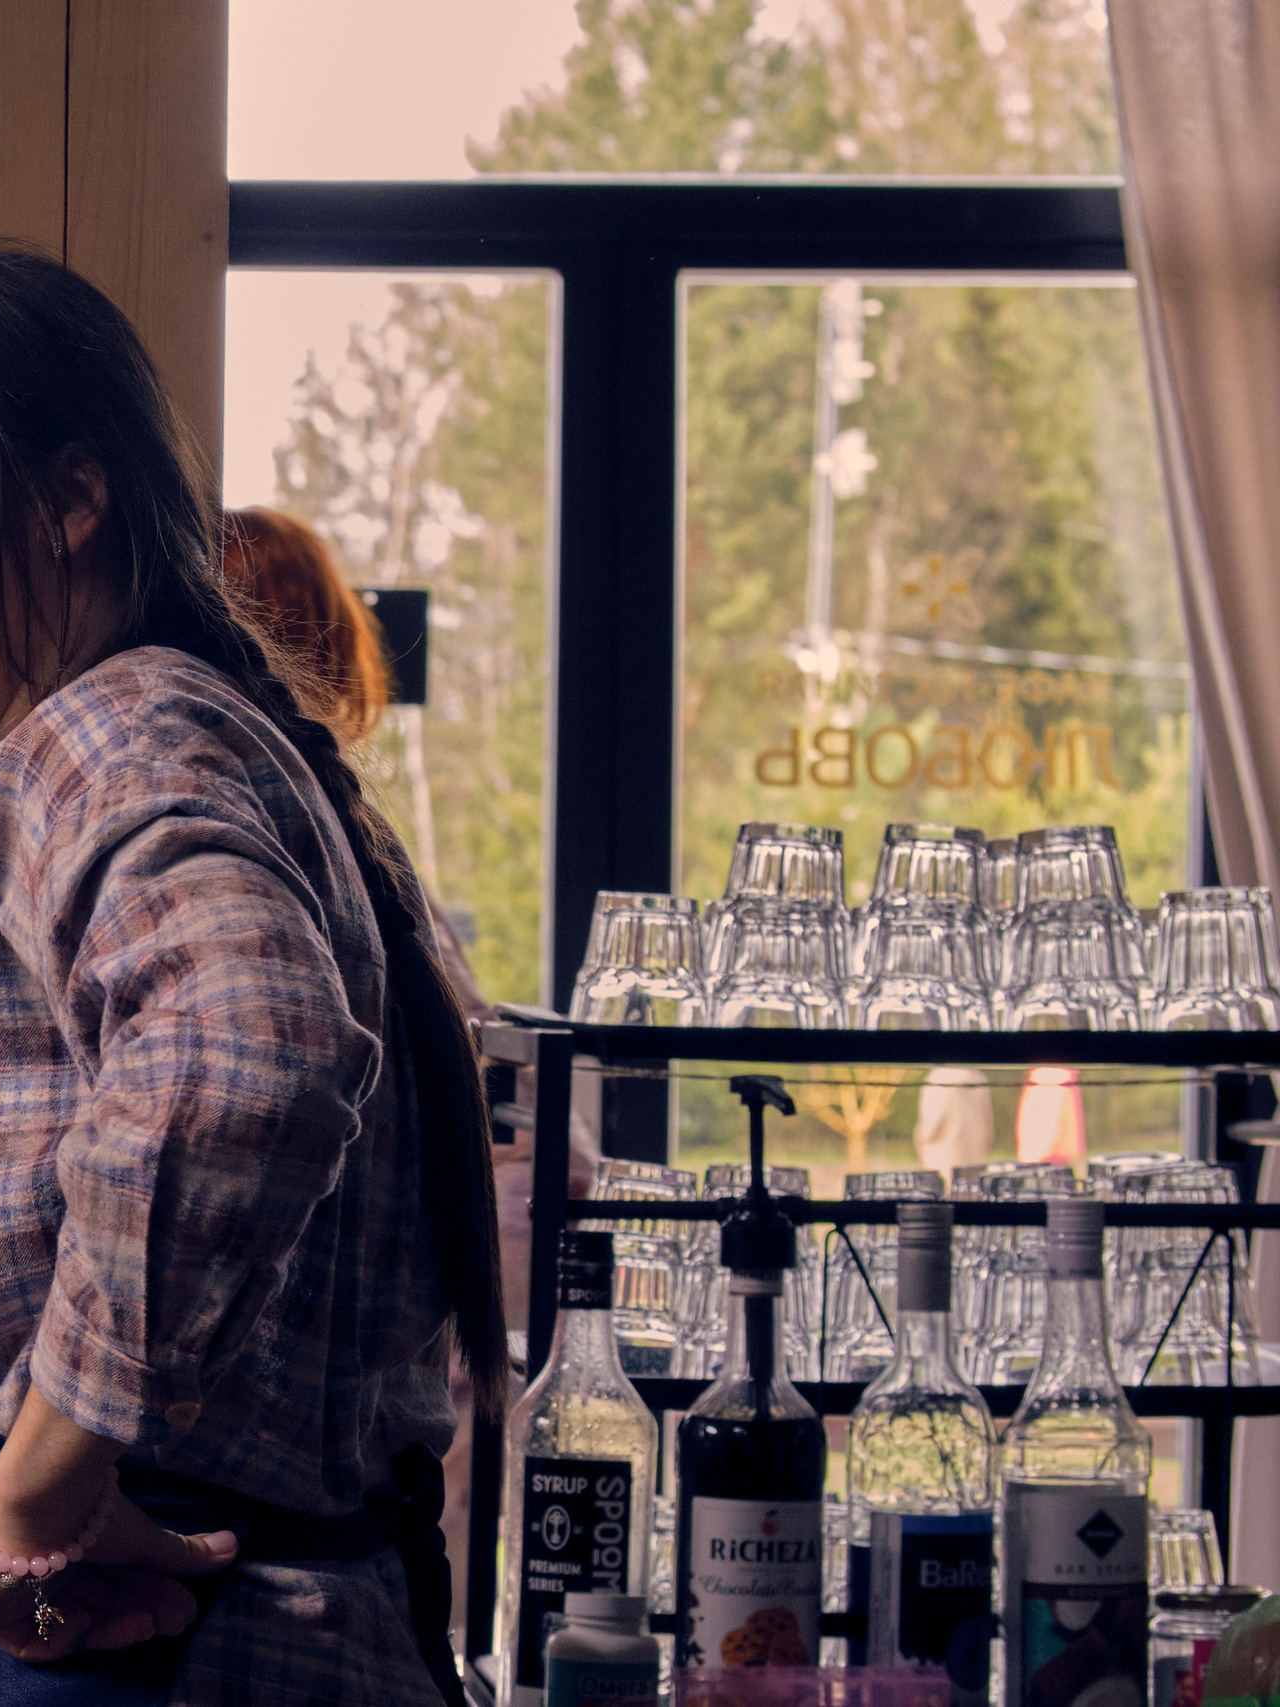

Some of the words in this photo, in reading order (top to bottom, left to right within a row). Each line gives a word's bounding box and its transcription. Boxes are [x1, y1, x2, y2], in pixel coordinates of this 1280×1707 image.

[532, 1473, 588, 1495] SYRUP
[529, 1558, 581, 1576] PREMIUM
[528, 1576, 565, 1594] SERIES
